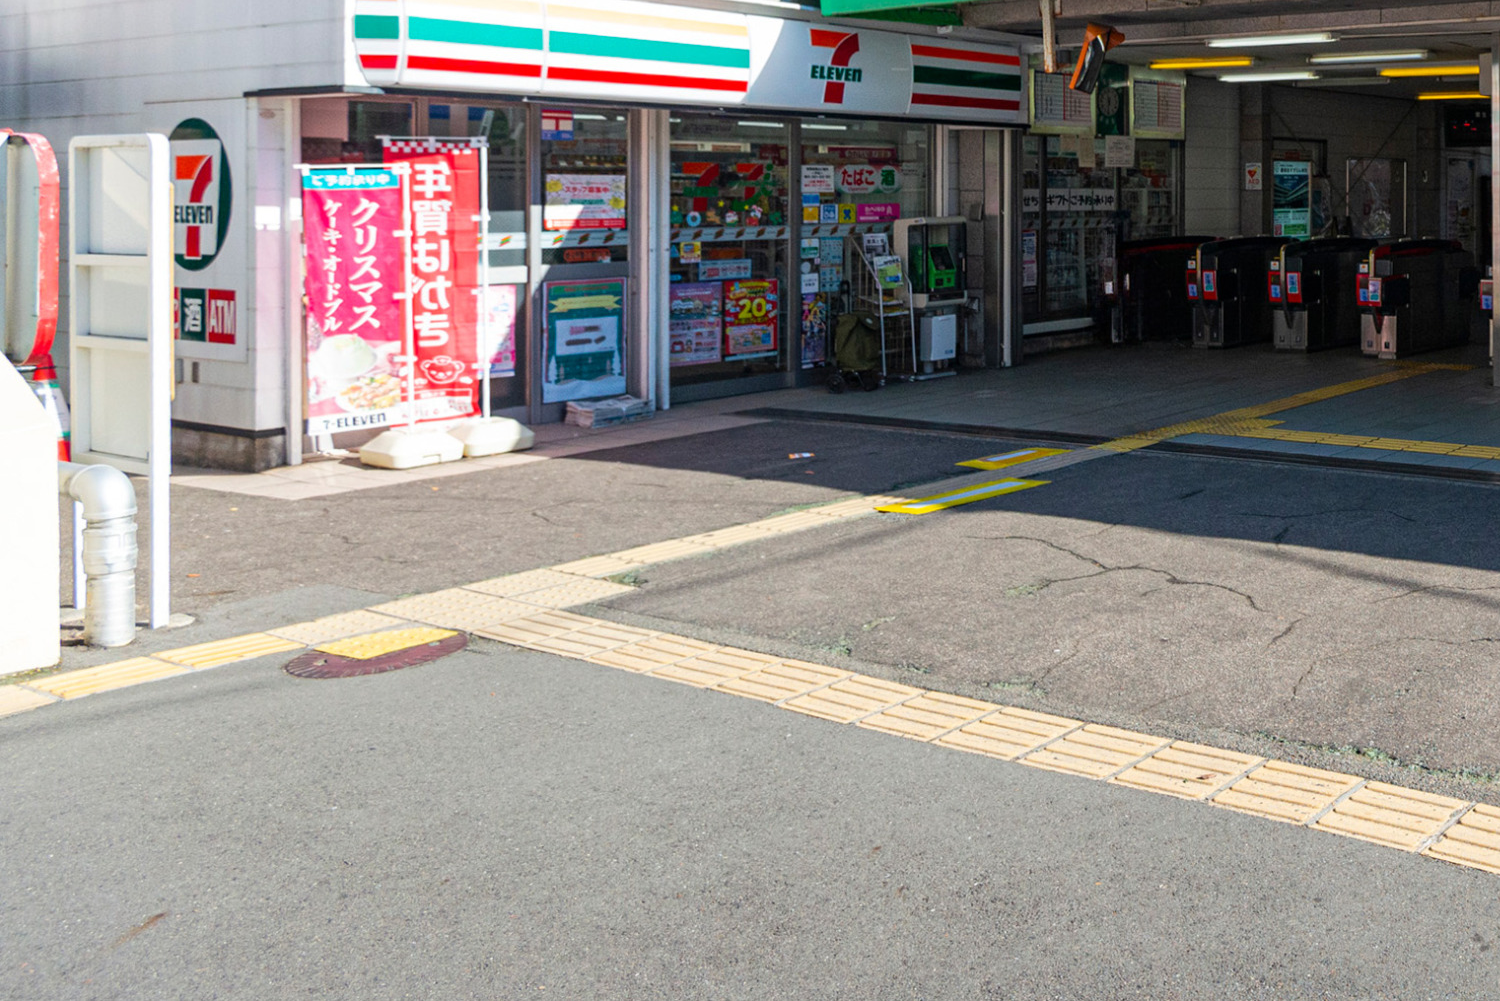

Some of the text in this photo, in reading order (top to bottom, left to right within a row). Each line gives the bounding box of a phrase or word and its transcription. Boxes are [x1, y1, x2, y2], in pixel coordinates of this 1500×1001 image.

[311, 173, 391, 187] ご予約承り中
[841, 168, 876, 186] たばこ
[880, 169, 896, 187] 酒
[348, 197, 384, 332] クリスマス
[183, 297, 203, 333] 酒
[209, 298, 236, 335] ATM
[738, 297, 767, 319] 20
